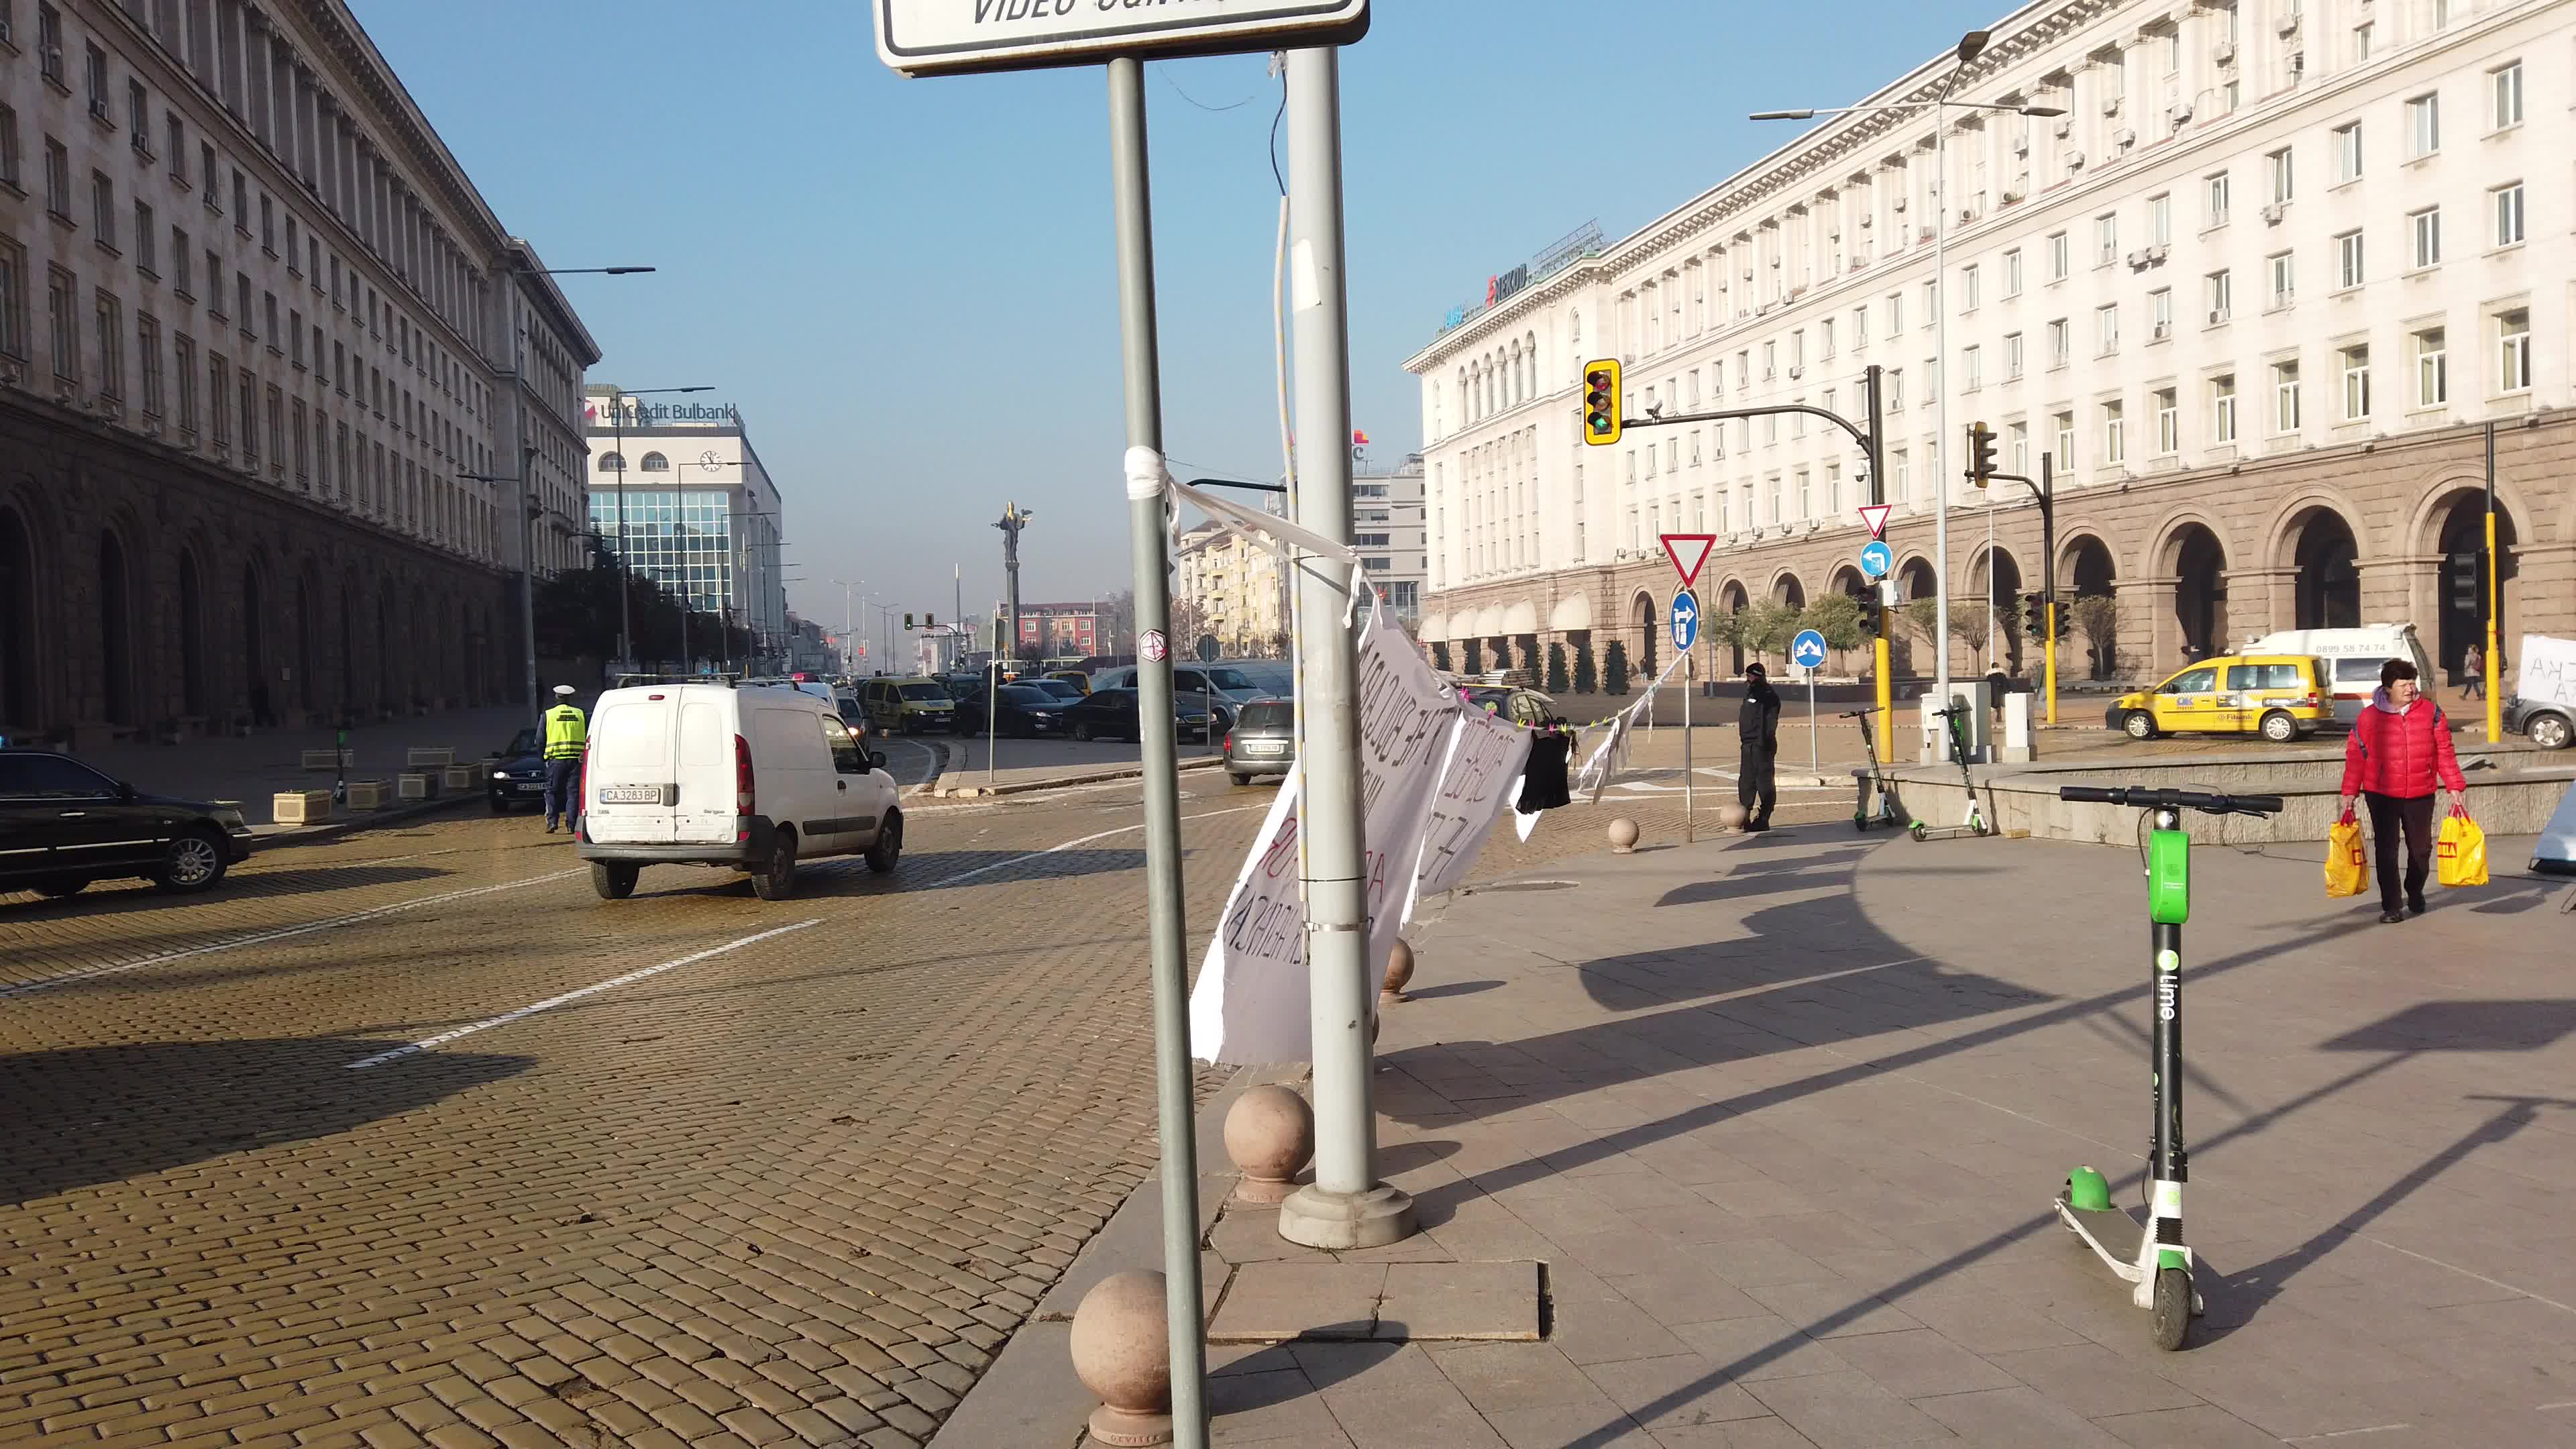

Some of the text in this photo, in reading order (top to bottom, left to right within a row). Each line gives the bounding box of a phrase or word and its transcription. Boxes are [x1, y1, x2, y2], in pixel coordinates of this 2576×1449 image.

[673, 402, 736, 419] Bulbank
[606, 791, 657, 800] CA 3283 BP
[2159, 975, 2178, 1020] Lime
